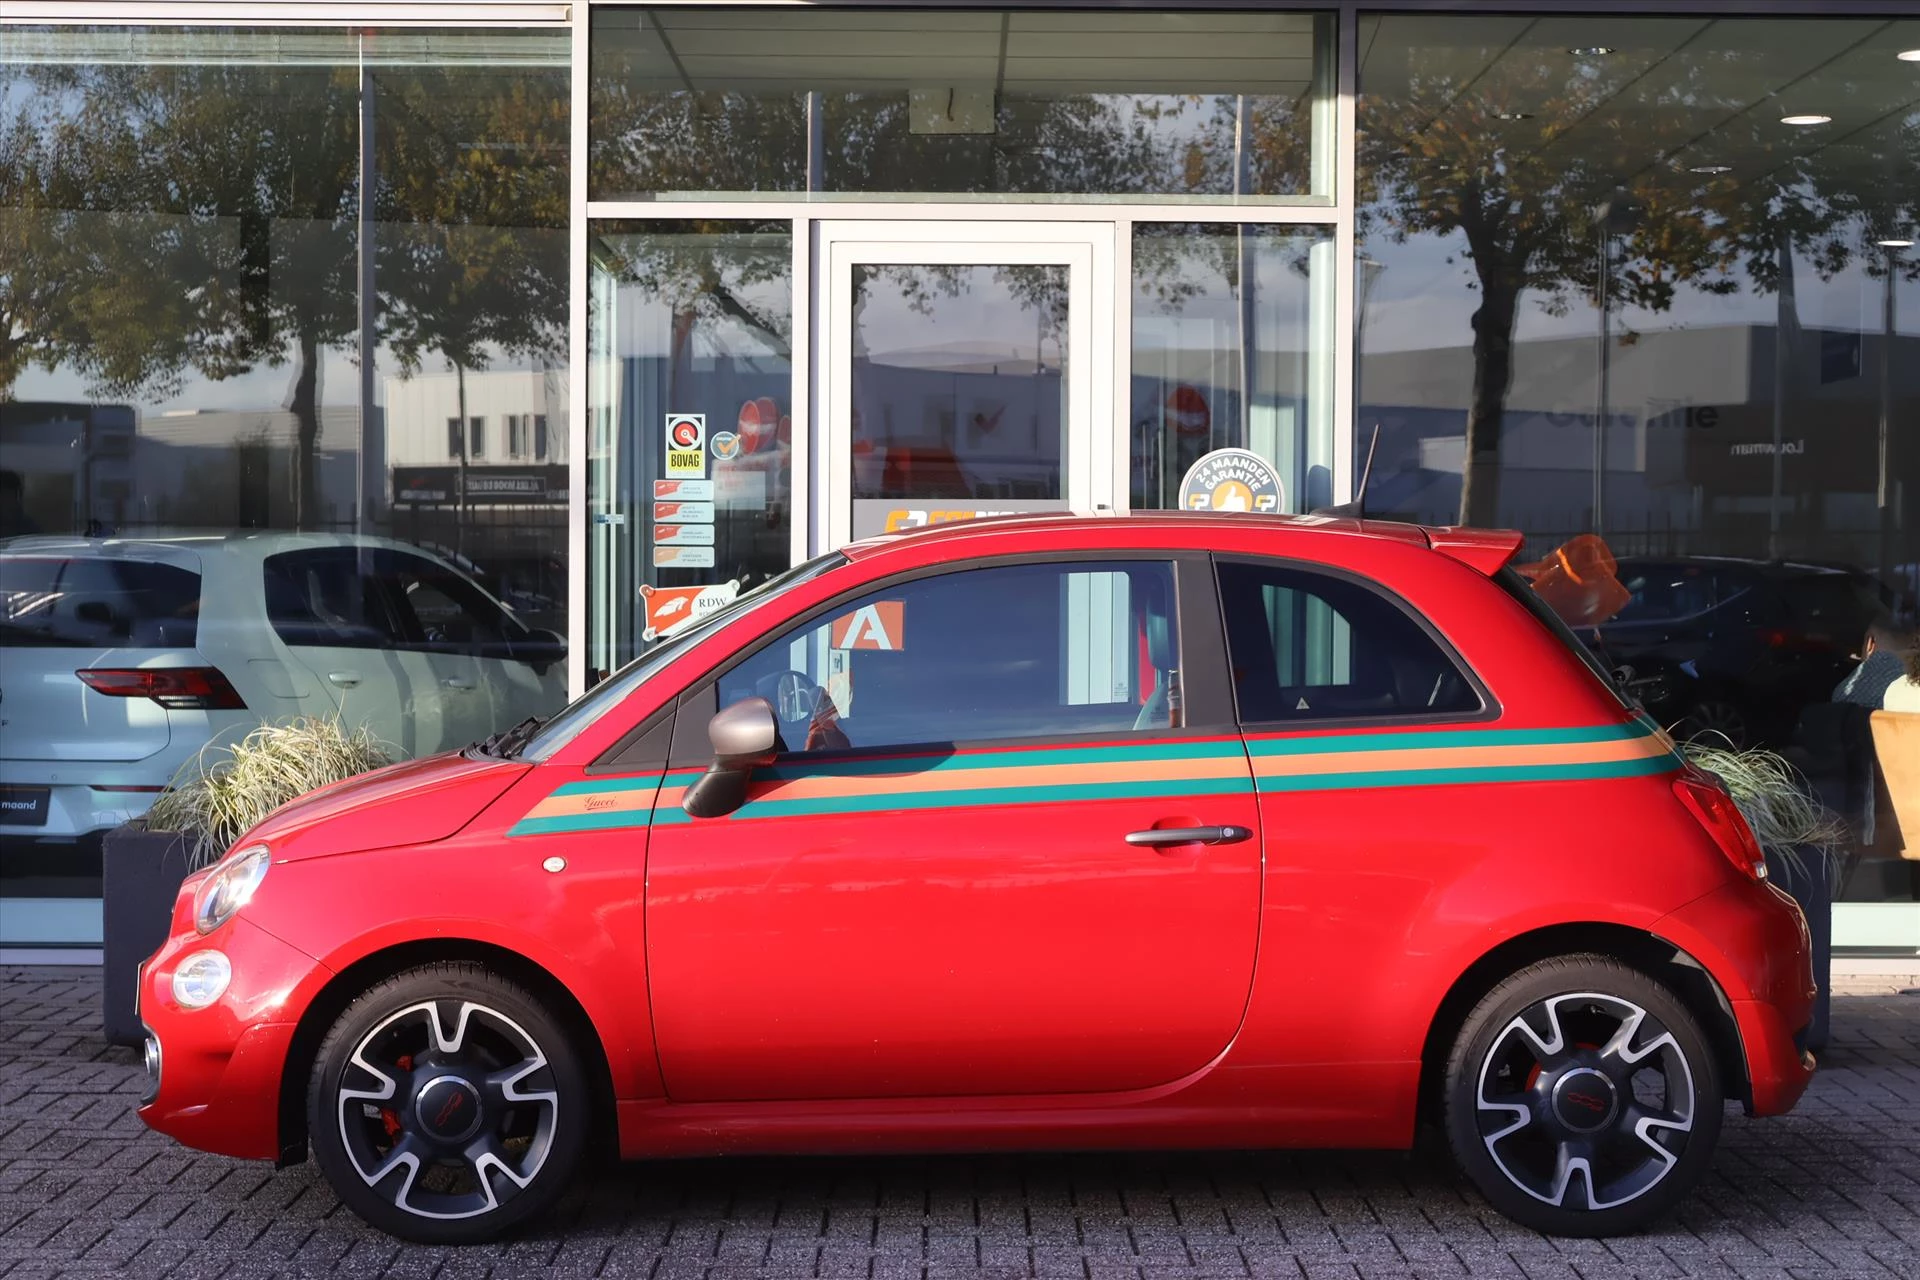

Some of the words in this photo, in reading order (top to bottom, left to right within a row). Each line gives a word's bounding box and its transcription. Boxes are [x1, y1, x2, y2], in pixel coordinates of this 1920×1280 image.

[671, 453, 700, 468] BOVAG
[1196, 468, 1212, 483] 24
[1211, 457, 1272, 485] MAANDEN
[1205, 469, 1262, 492] GARANTIE
[699, 597, 727, 608] RDW
[1, 799, 37, 810] maand
[584, 796, 618, 810] Gucci
